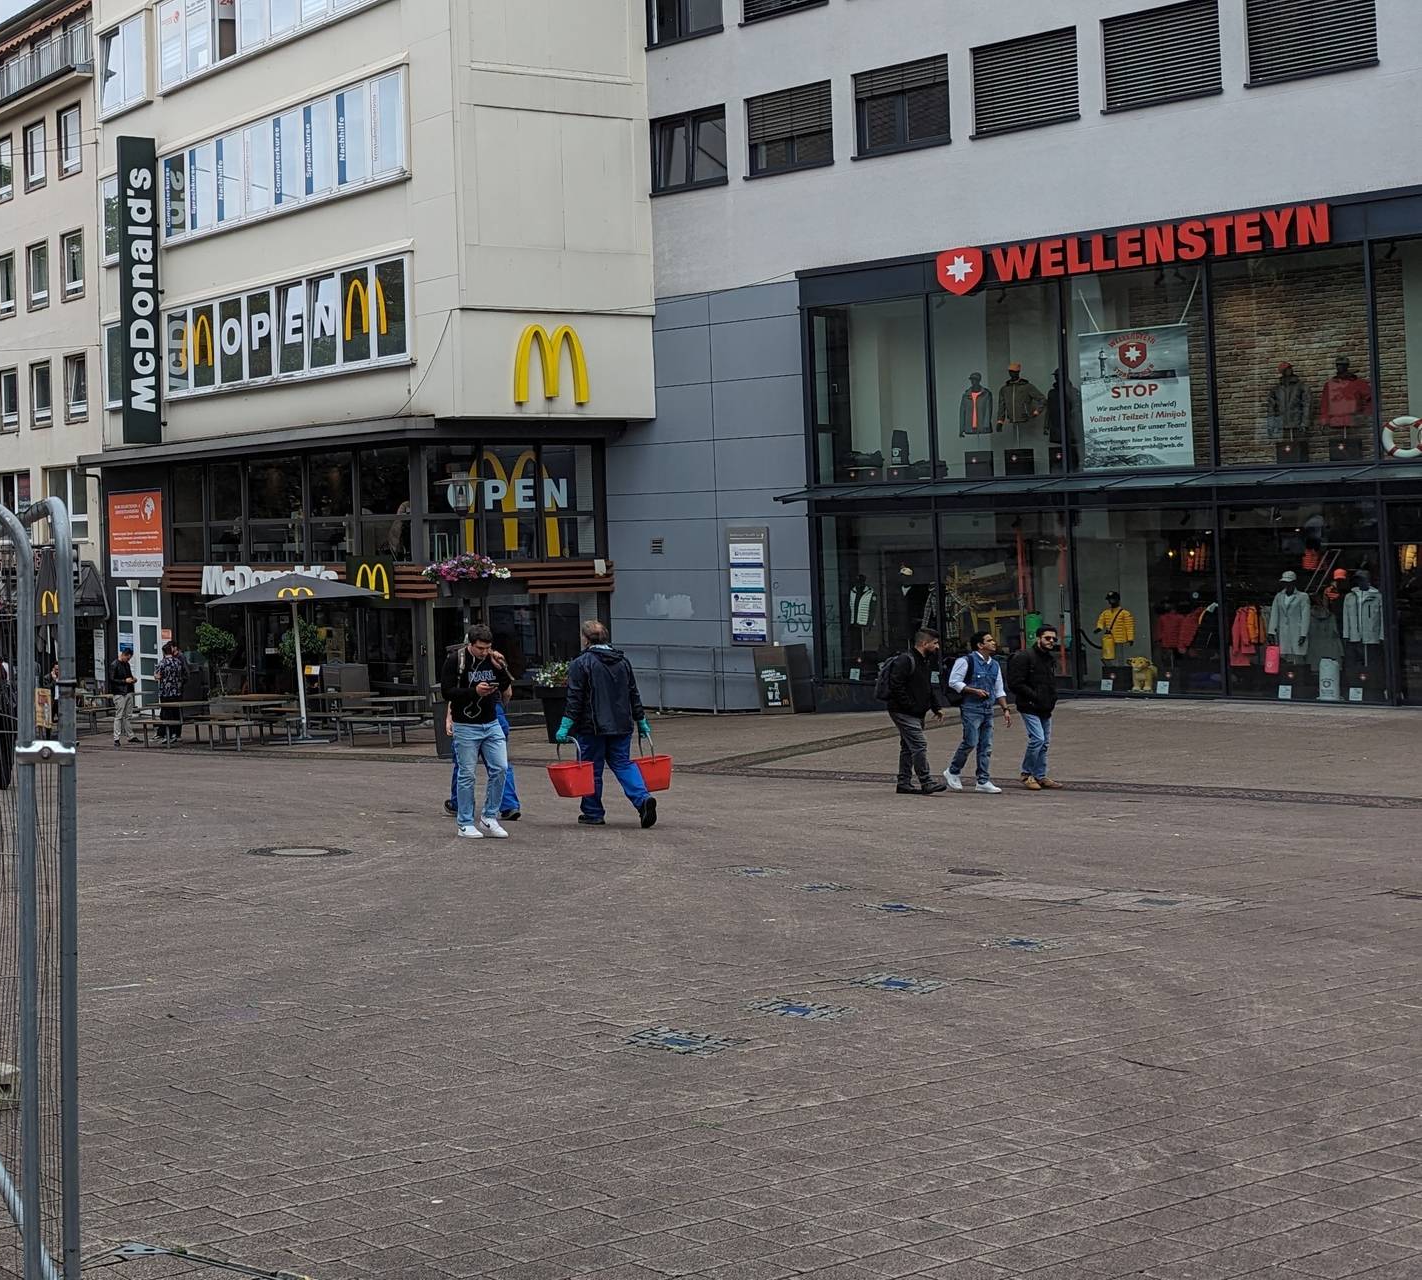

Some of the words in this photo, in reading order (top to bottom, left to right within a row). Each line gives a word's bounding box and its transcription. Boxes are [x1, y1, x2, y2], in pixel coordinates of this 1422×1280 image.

[991, 204, 1330, 282] WELLENSTEYN
[127, 167, 156, 413] McDonald's
[221, 303, 337, 356] OPEN
[1111, 383, 1158, 399] STOP
[1134, 402, 1149, 410] Dich
[1090, 414, 1116, 423] Vollzeit
[1123, 413, 1148, 421] Teilzeit
[1155, 410, 1187, 419] Minijob
[1099, 424, 1135, 433] Verstärkung
[1137, 424, 1147, 432] für
[447, 478, 568, 510] OPEN
[201, 565, 339, 597] McDo'
